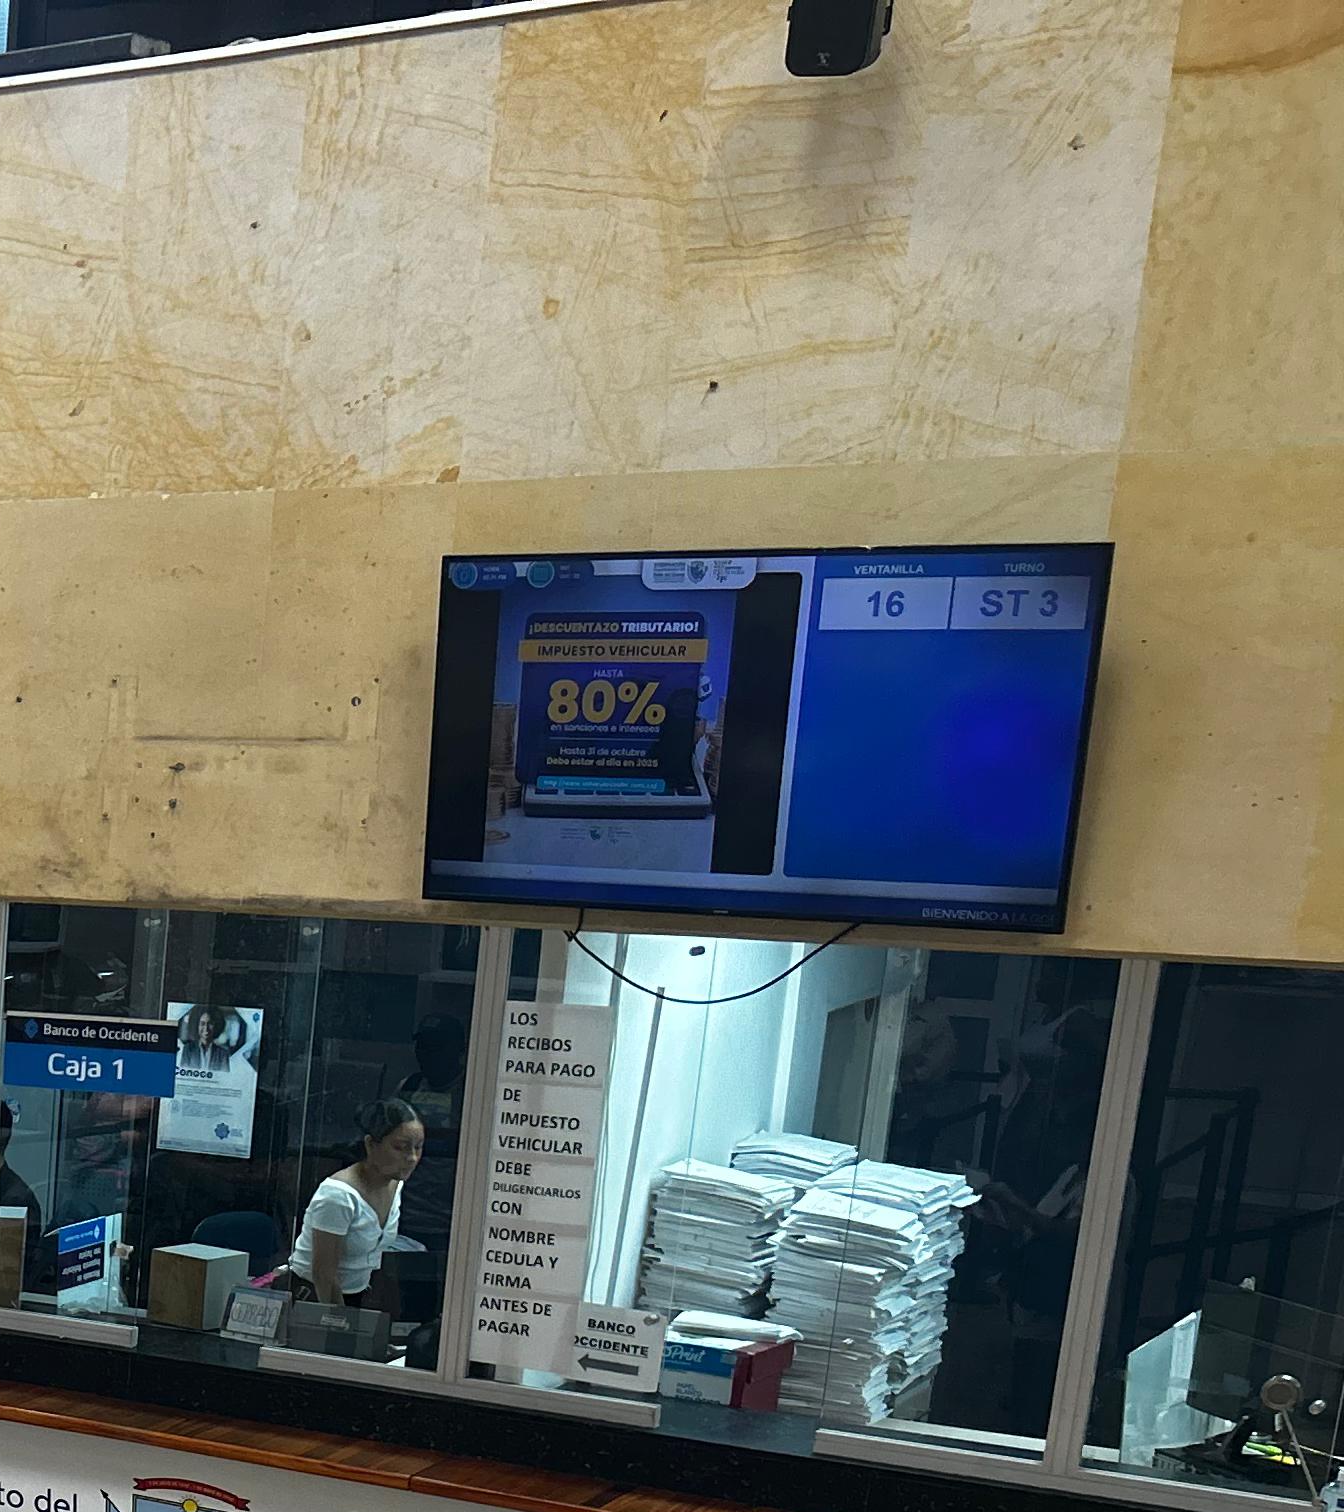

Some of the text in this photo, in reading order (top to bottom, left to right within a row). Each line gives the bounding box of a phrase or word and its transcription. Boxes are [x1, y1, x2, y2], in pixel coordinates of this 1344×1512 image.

[853, 564, 924, 575] VENTANILLA
[1003, 562, 1045, 573] TURNO
[867, 590, 905, 617] 16
[979, 590, 1059, 617] ST 3
[529, 621, 699, 635] ¡DESCUENTAZO TRIBUTARIO!
[537, 645, 686, 657] IMPUESTO VEHICULAR
[594, 669, 624, 678] HASTA
[547, 679, 666, 725] 80%
[509, 1012, 538, 1026] LOS
[43, 1023, 159, 1043] Banco de Occidente
[507, 1036, 572, 1052] RECIBOS
[47, 1053, 124, 1082] Caja 1
[505, 1059, 596, 1078] PARA PAGO
[503, 1087, 522, 1102] DE
[500, 1111, 580, 1131] IMPUESTO
[498, 1134, 583, 1155] VEHICULAR
[495, 1159, 532, 1176] DEBE
[492, 1181, 582, 1199] DILIGENCIARLOS
[491, 1200, 523, 1216] CON
[488, 1226, 556, 1246] NOMBRE
[485, 1249, 559, 1269] CEDULA Y
[483, 1272, 532, 1290] FIRMA
[479, 1296, 553, 1317] ANTES DE
[478, 1318, 530, 1337] PAGAR
[587, 1318, 636, 1335] BANCO
